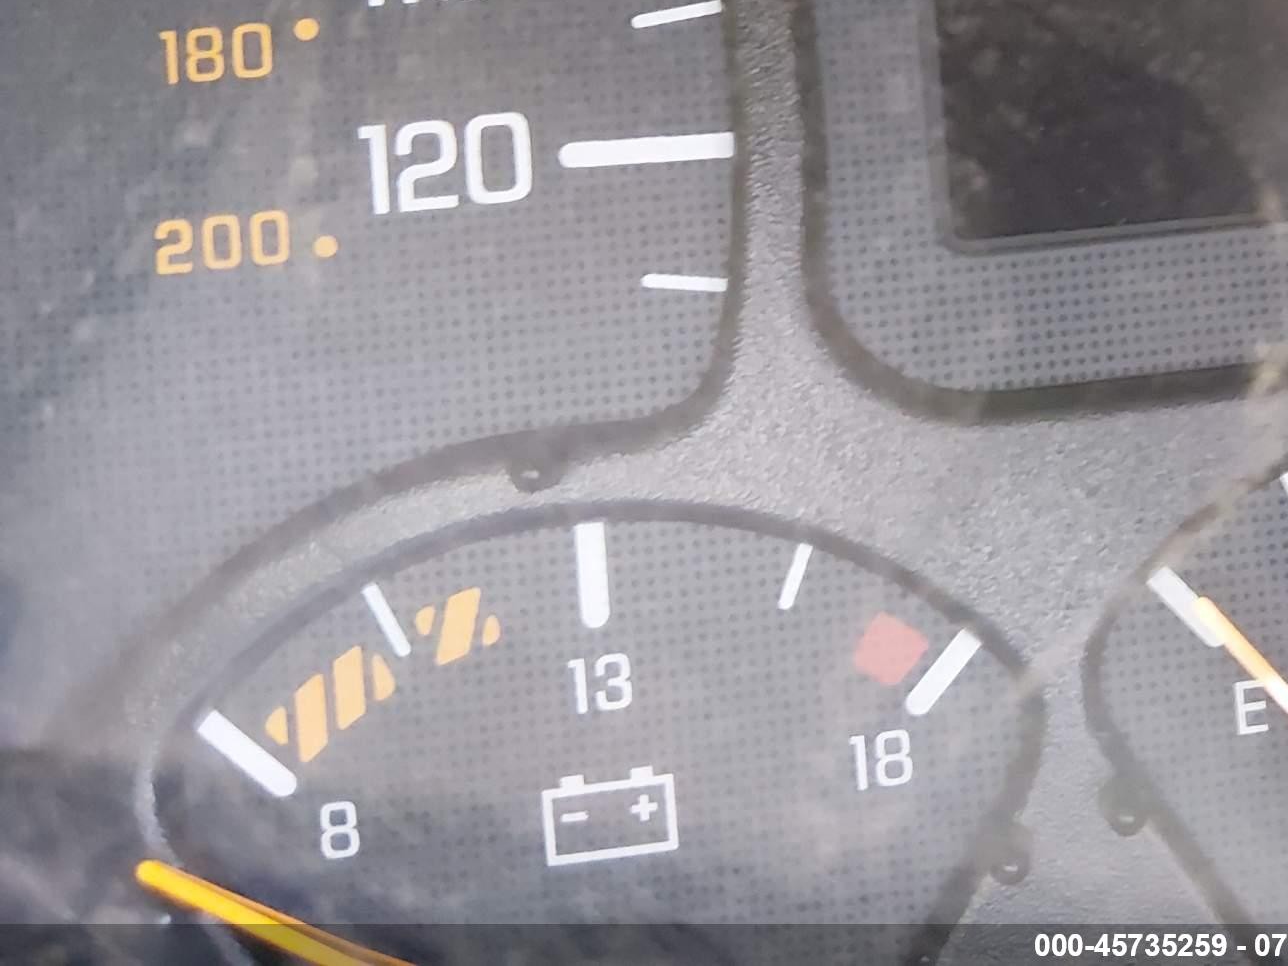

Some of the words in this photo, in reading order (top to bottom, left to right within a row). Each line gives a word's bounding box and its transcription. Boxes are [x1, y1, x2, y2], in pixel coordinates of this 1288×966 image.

[159, 23, 273, 85] 180
[358, 112, 533, 215] 120
[154, 210, 290, 275] 200
[567, 653, 633, 714] 13
[1233, 681, 1269, 734] E
[849, 730, 913, 791] 18
[320, 801, 361, 860] 8
